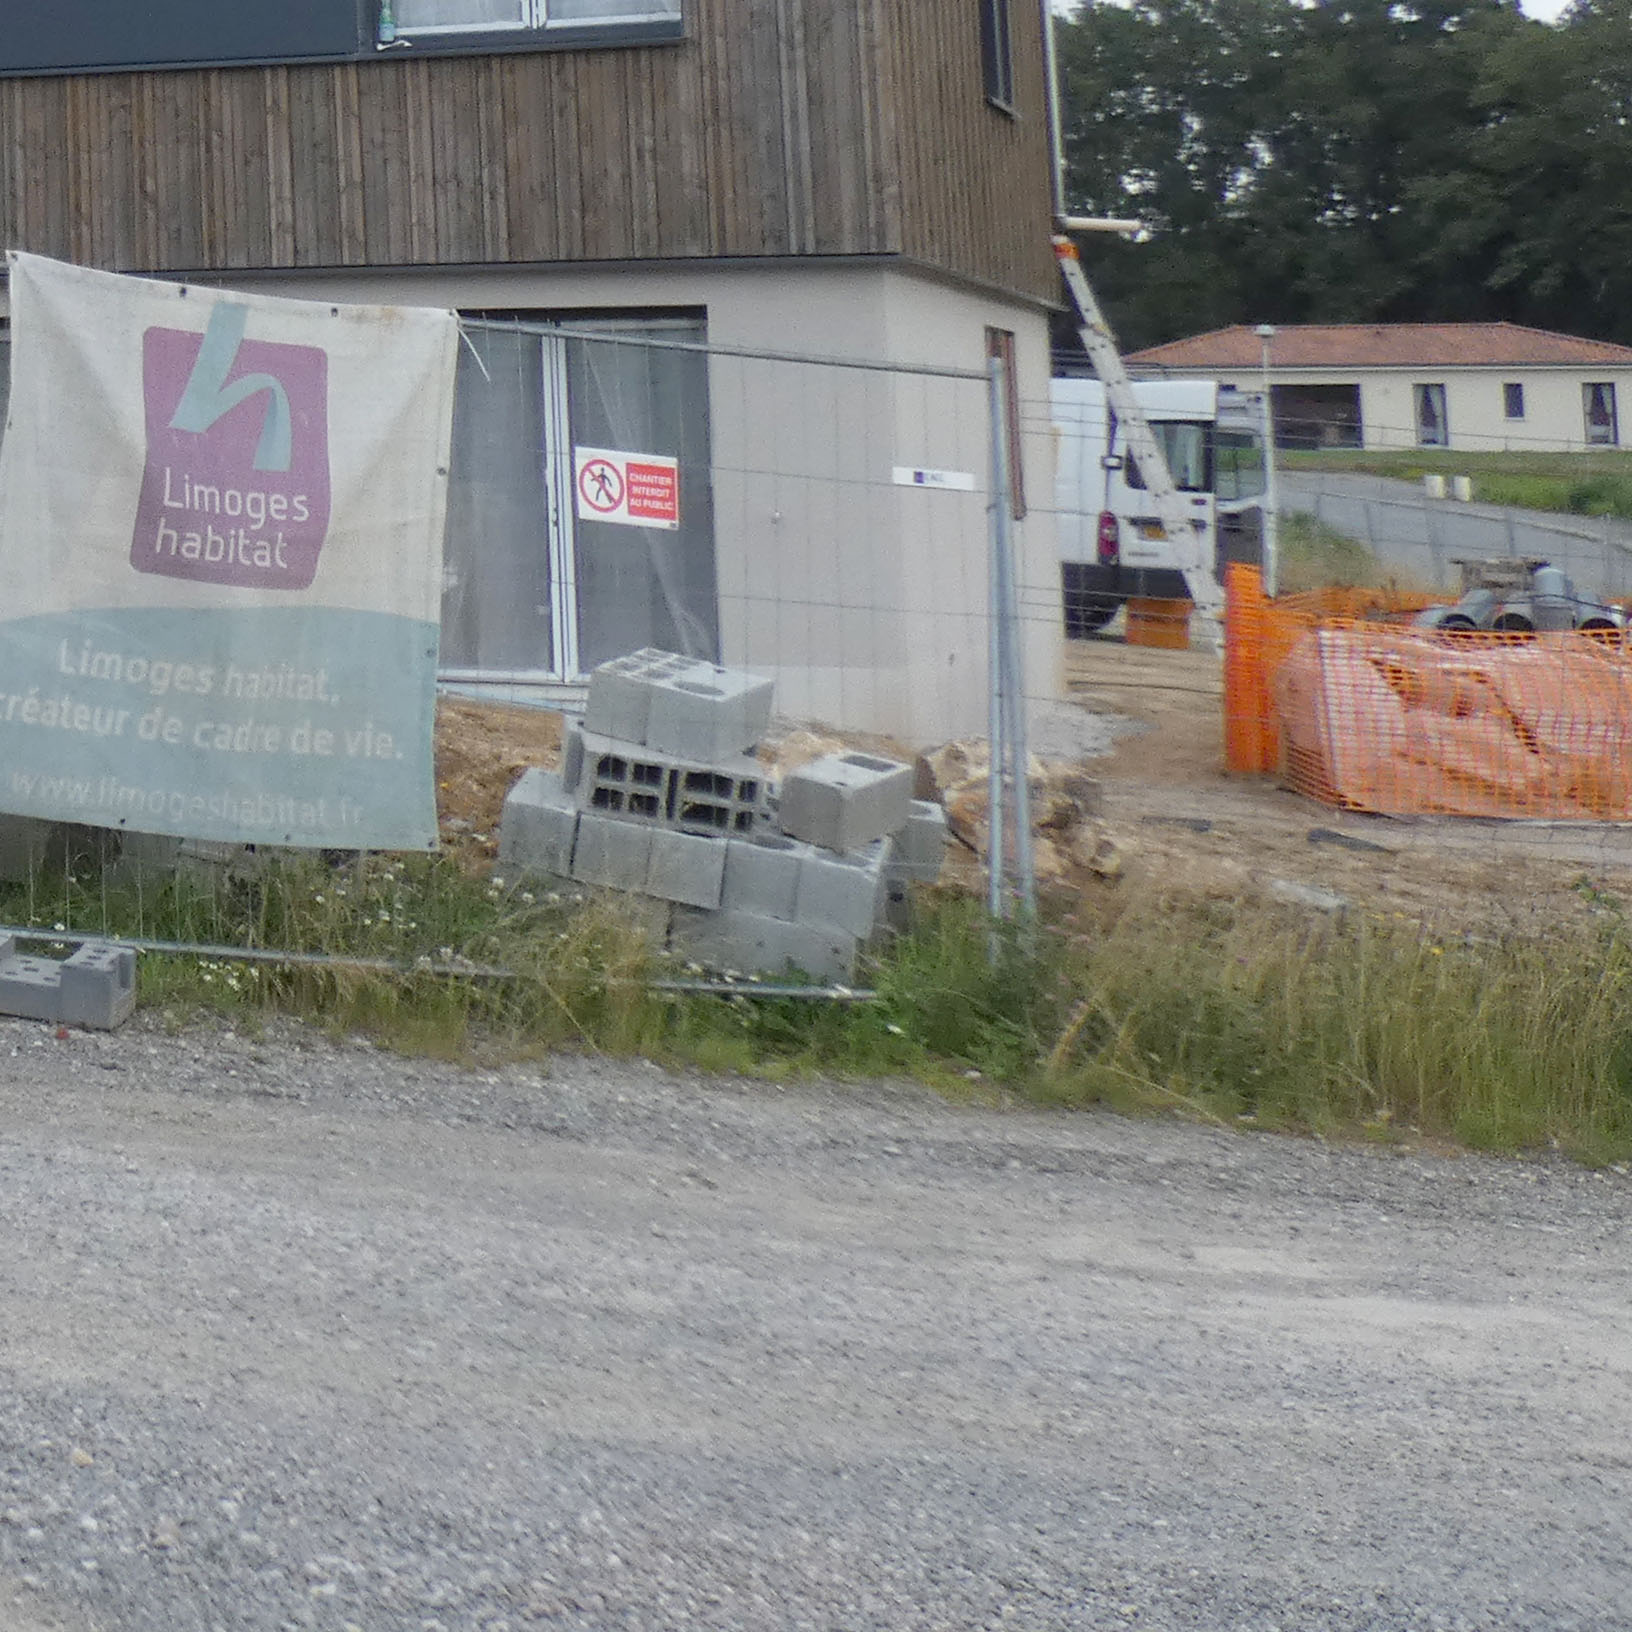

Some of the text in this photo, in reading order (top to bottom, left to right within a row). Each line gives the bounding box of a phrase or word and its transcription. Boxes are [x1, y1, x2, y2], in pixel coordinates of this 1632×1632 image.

[163, 467, 310, 530] Limoges
[629, 472, 673, 485] CHANTIER
[629, 498, 674, 511] AU PUBLIC
[631, 485, 671, 498] INTERDIT
[155, 517, 288, 569] habitat
[58, 638, 340, 704] Limoges habitat,
[138, 706, 183, 744] de
[193, 718, 281, 754] cadre
[289, 718, 335, 756] de
[344, 721, 404, 761] vie.
[11, 769, 364, 825] www.limogeshabitat.fr
